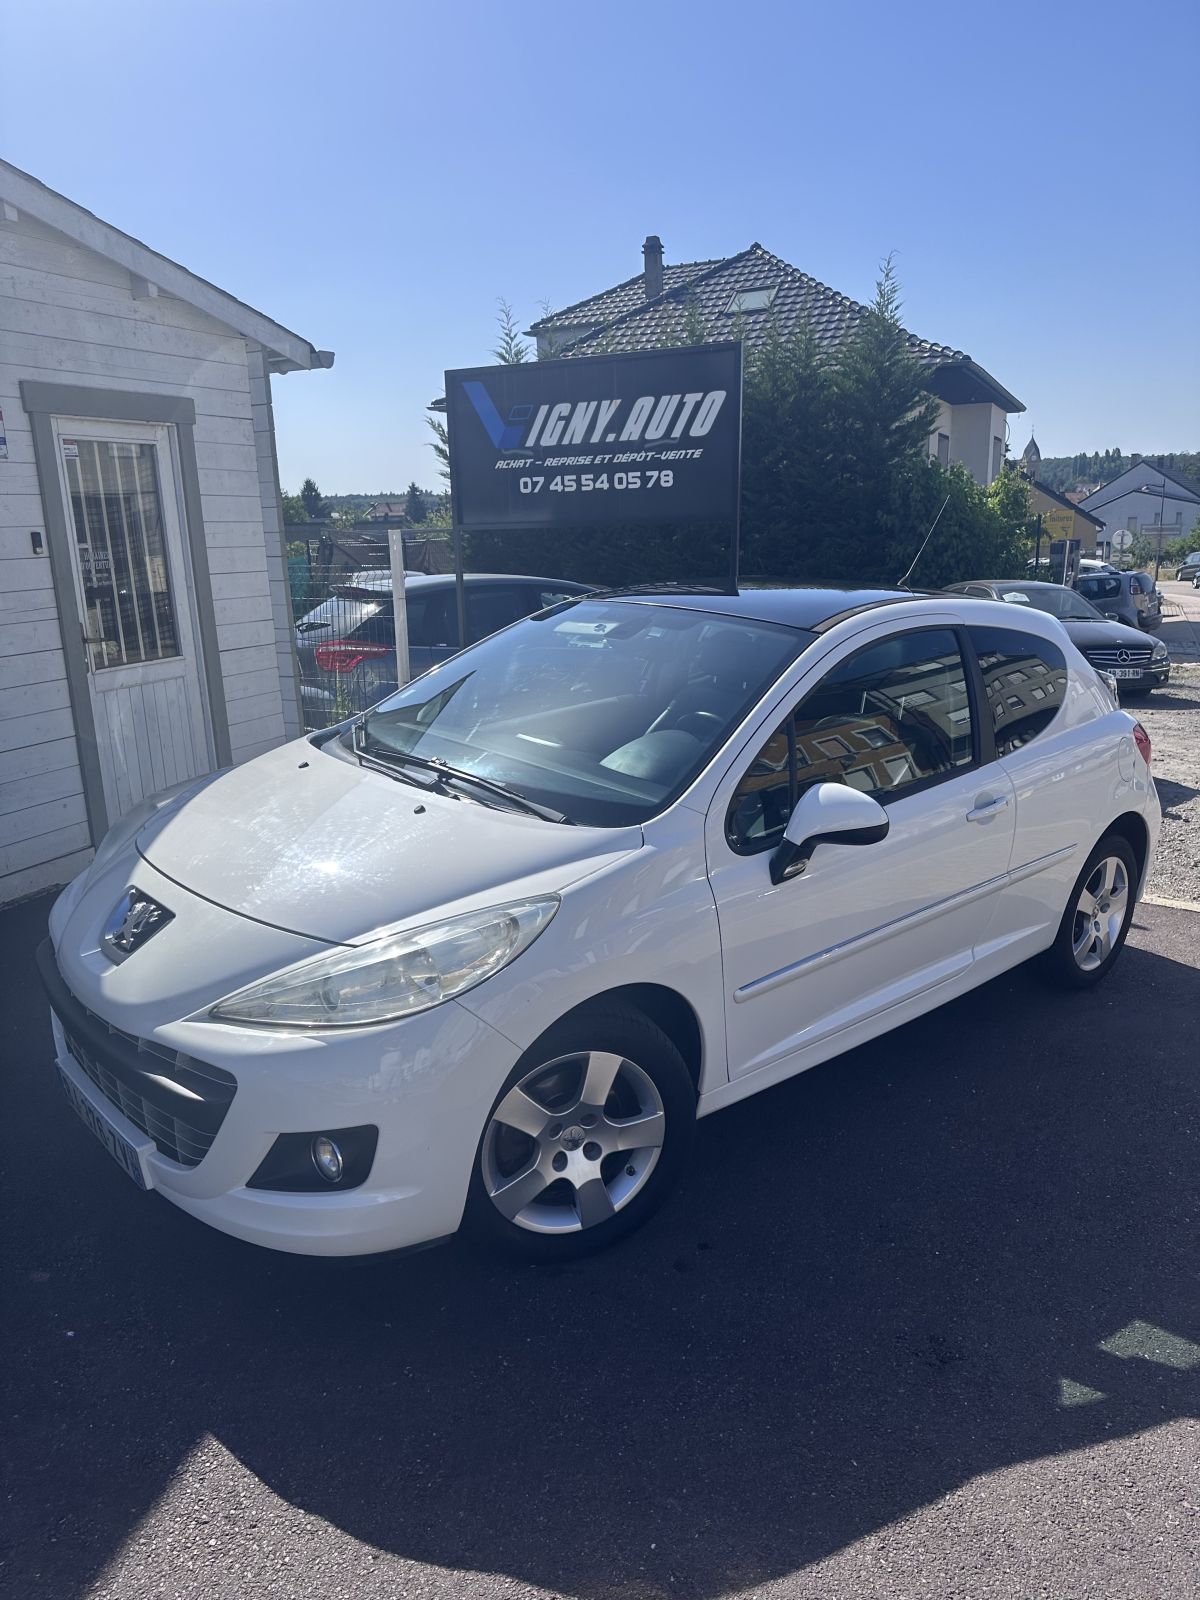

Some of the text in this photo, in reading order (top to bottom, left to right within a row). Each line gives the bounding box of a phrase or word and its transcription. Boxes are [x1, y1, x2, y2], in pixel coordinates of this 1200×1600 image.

[495, 458, 534, 469] ACHAT
[544, 455, 594, 467] REPRISE
[594, 454, 613, 464] ET
[613, 448, 704, 463] DÉPÔT-VENTE
[520, 470, 674, 494] 07 45 54 05 78
